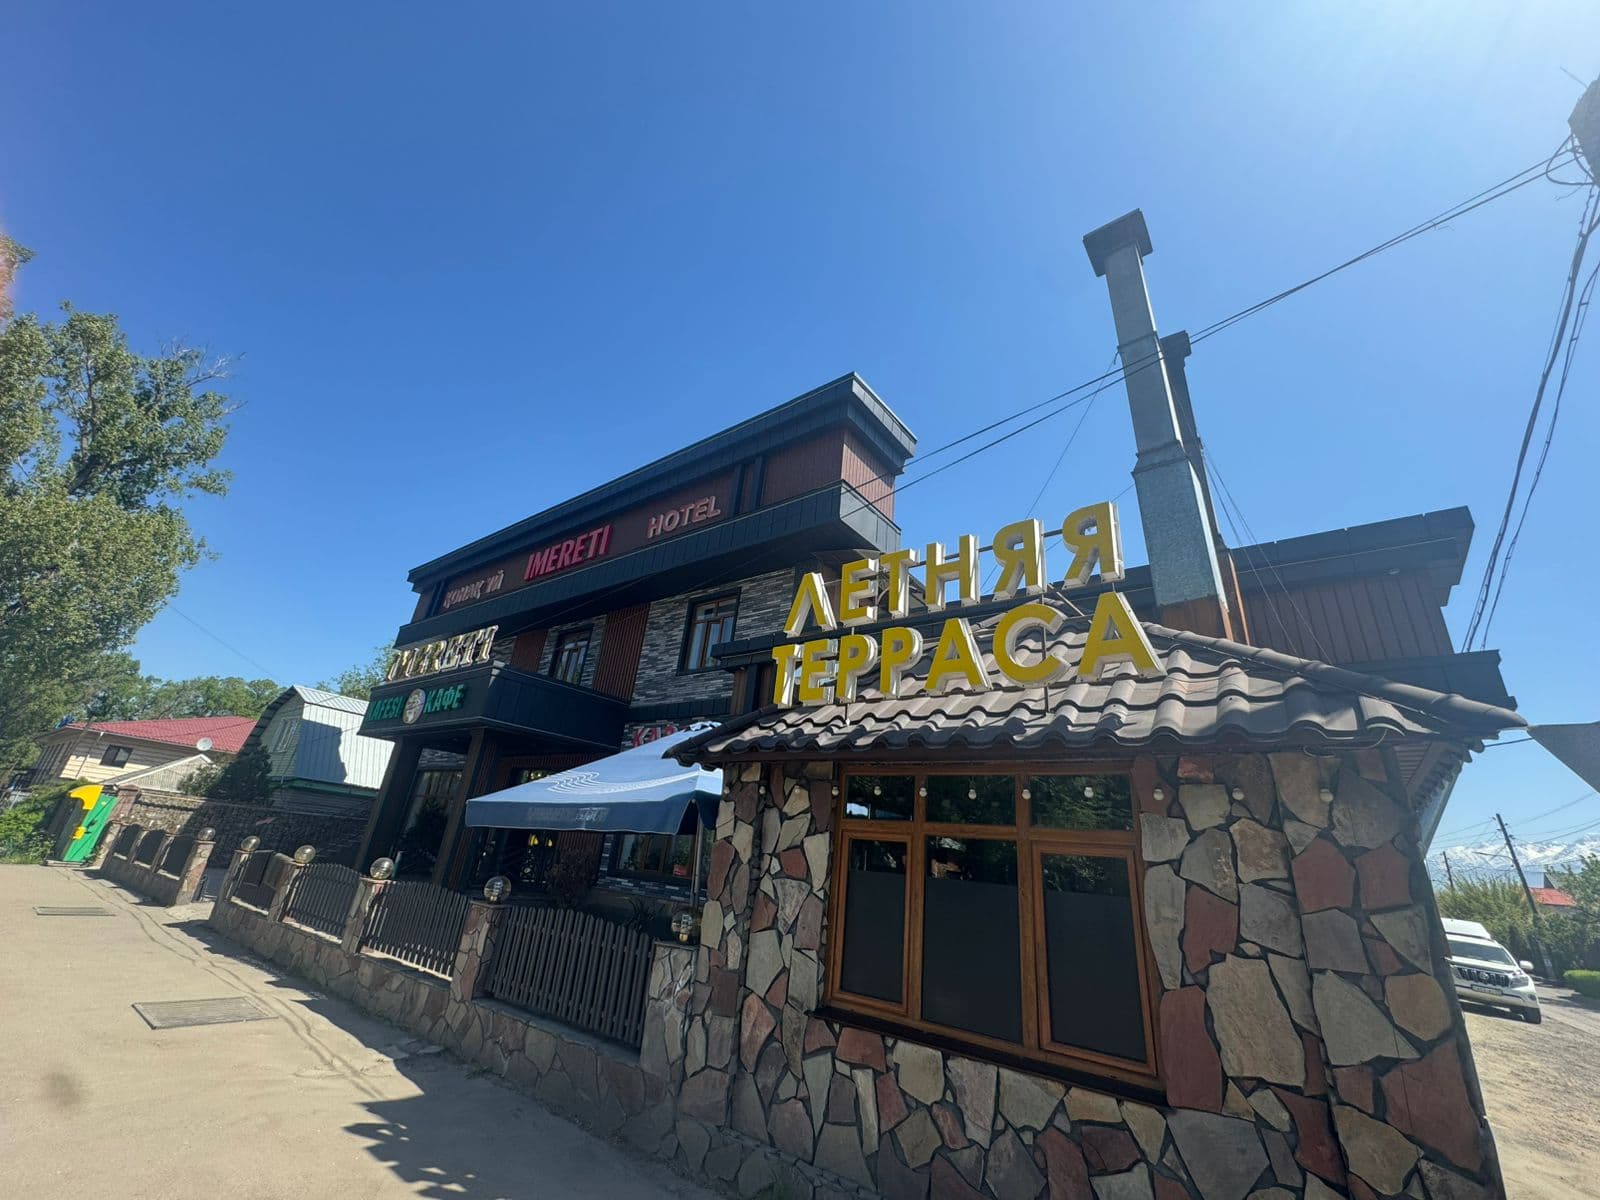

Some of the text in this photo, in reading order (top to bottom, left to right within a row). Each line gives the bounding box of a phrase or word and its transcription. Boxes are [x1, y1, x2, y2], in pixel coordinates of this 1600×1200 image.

[523, 496, 721, 581] IMERETI HOTEL
[783, 501, 1125, 637] ЛЕТНЯЯ
[424, 684, 465, 713] КАФЕ
[772, 591, 1167, 709] ТЕРРАСА
